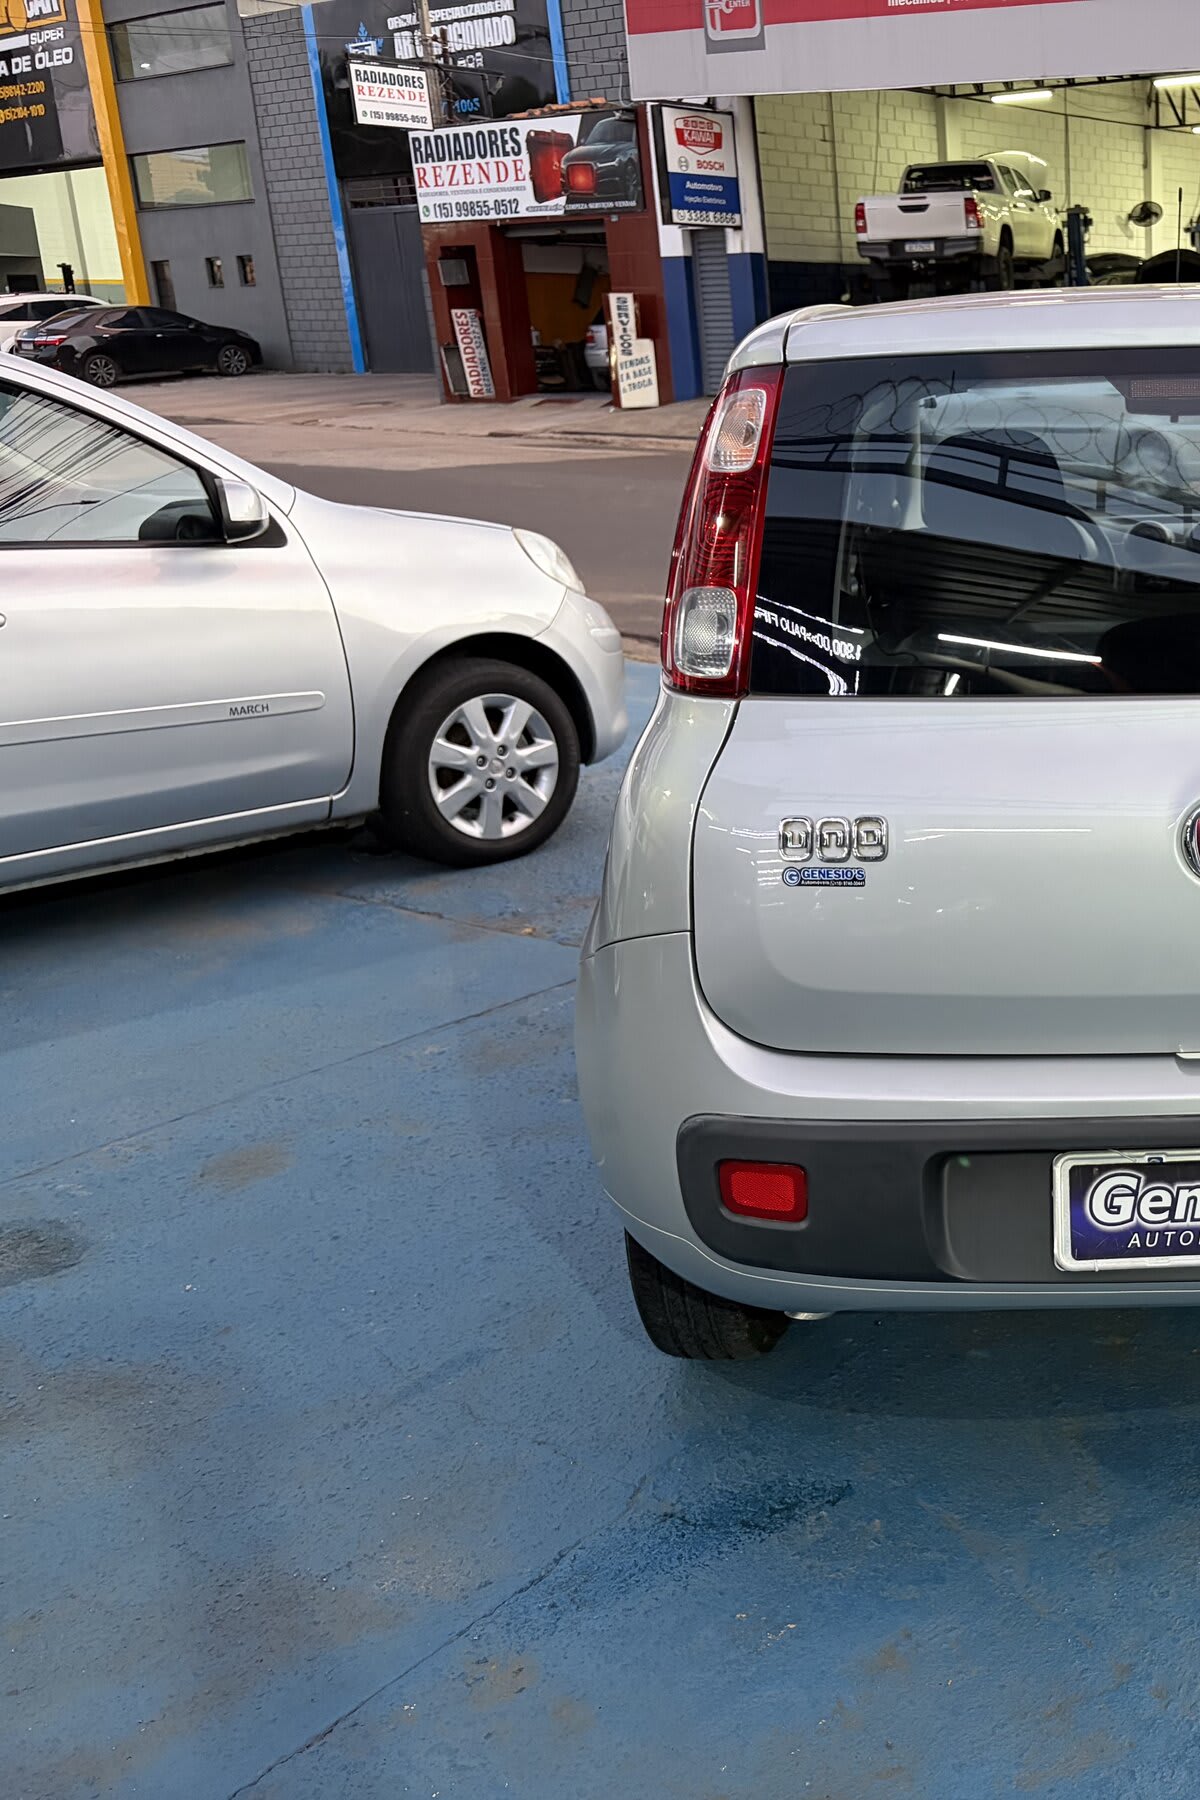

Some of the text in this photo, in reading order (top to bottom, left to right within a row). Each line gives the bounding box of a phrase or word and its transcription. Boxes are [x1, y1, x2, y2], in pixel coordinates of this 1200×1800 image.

[30, 27, 64, 45] SUPER
[11, 55, 32, 75] DE
[35, 45, 73, 70] ÓLEO
[354, 69, 424, 89] RADIADORES
[356, 84, 427, 103] REZENDE
[385, 111, 429, 124] 99855-0512
[411, 127, 522, 164] RADIADORES
[683, 130, 715, 144] KAWAI
[416, 159, 526, 189] REZENDE
[696, 160, 725, 172] BOSCH
[433, 203, 453, 218] (15)
[455, 198, 520, 217] 99855-0512
[454, 311, 485, 395] RADIADORES
[619, 355, 651, 370] VENDAS
[229, 703, 270, 717] MARCH
